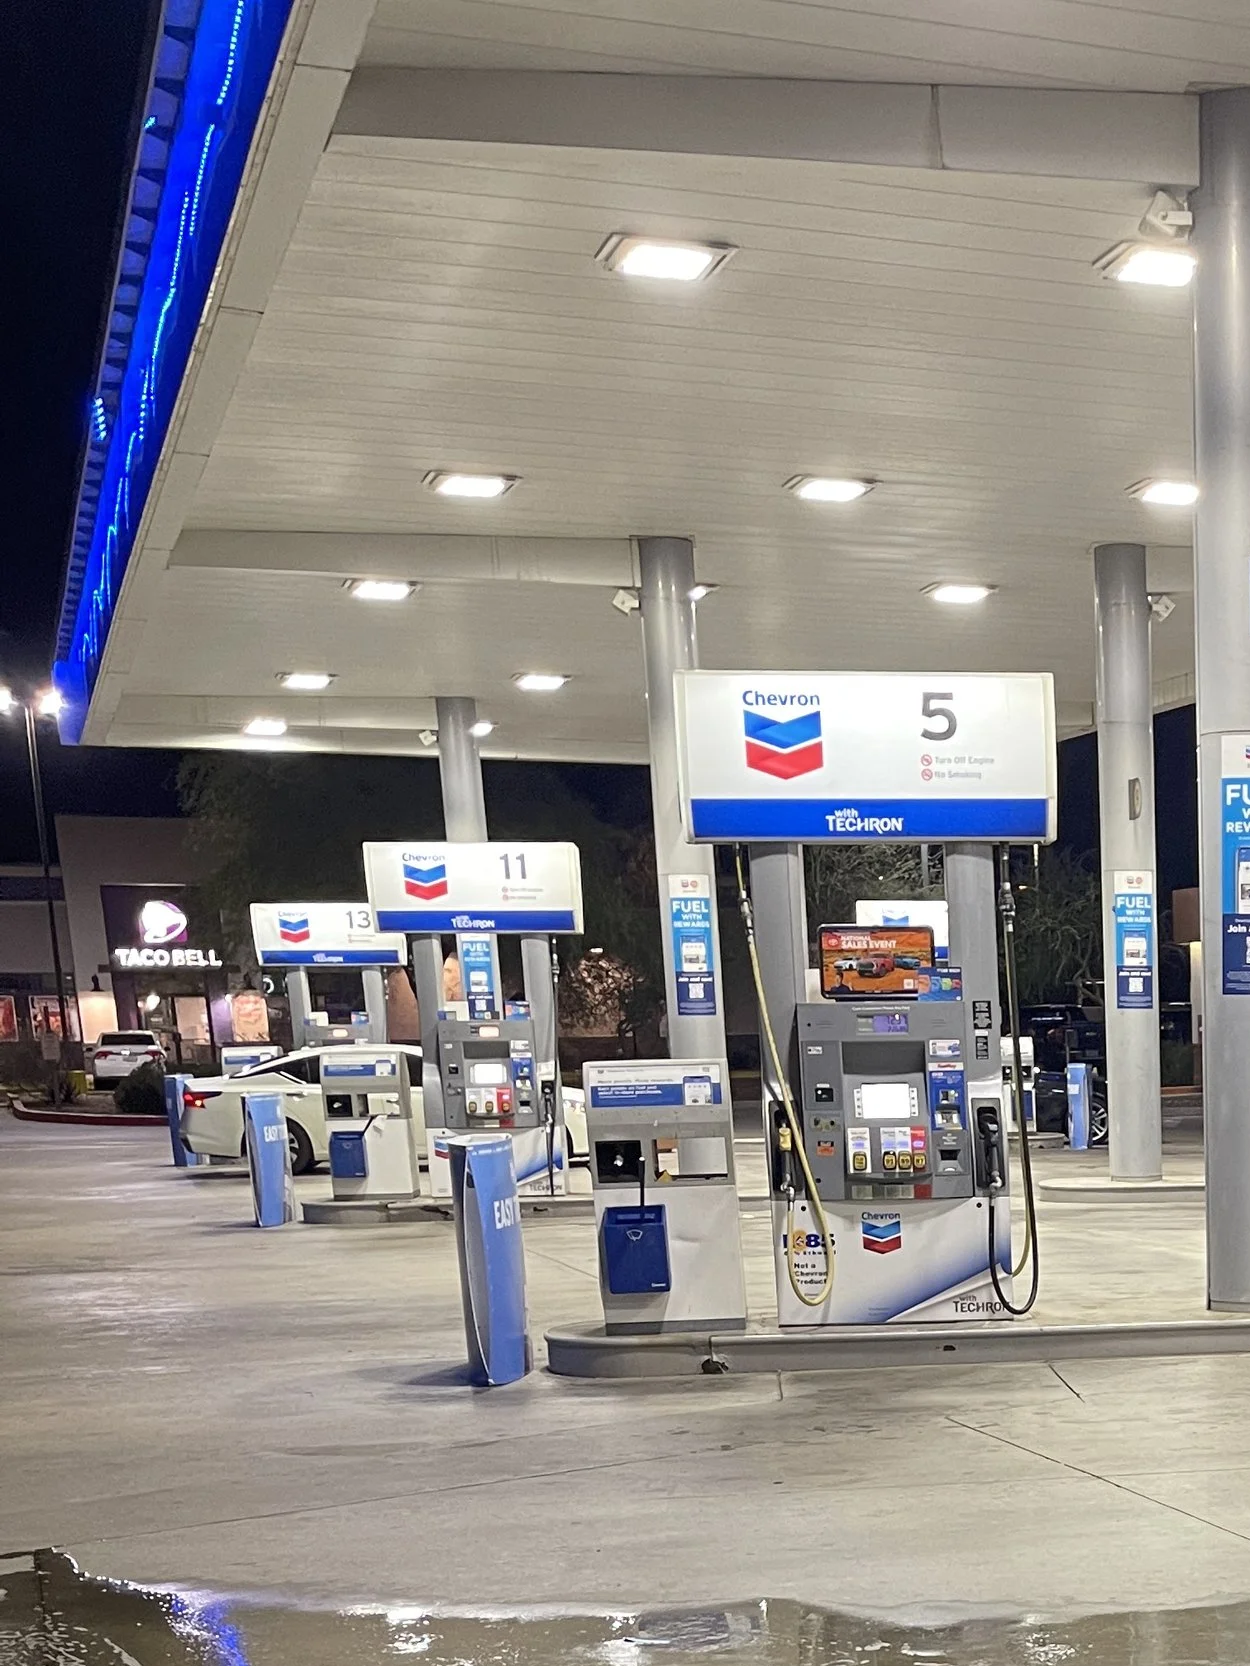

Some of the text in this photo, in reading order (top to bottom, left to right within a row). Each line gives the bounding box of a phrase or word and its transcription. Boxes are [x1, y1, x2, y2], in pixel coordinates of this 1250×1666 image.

[742, 690, 821, 706] Chevron
[919, 692, 958, 741] 5
[834, 808, 859, 818] with
[825, 815, 904, 834] TECHRON
[401, 852, 446, 862] Chevron
[499, 853, 527, 880] 11
[672, 900, 709, 913] FUEL
[1116, 896, 1152, 909] FUEL
[345, 910, 372, 929] 13
[1227, 924, 1247, 934] Join
[841, 940, 897, 949] SALES EVENT
[114, 948, 223, 967] TACO BELL
[861, 1211, 901, 1220] Chevron
[959, 1294, 977, 1302] with
